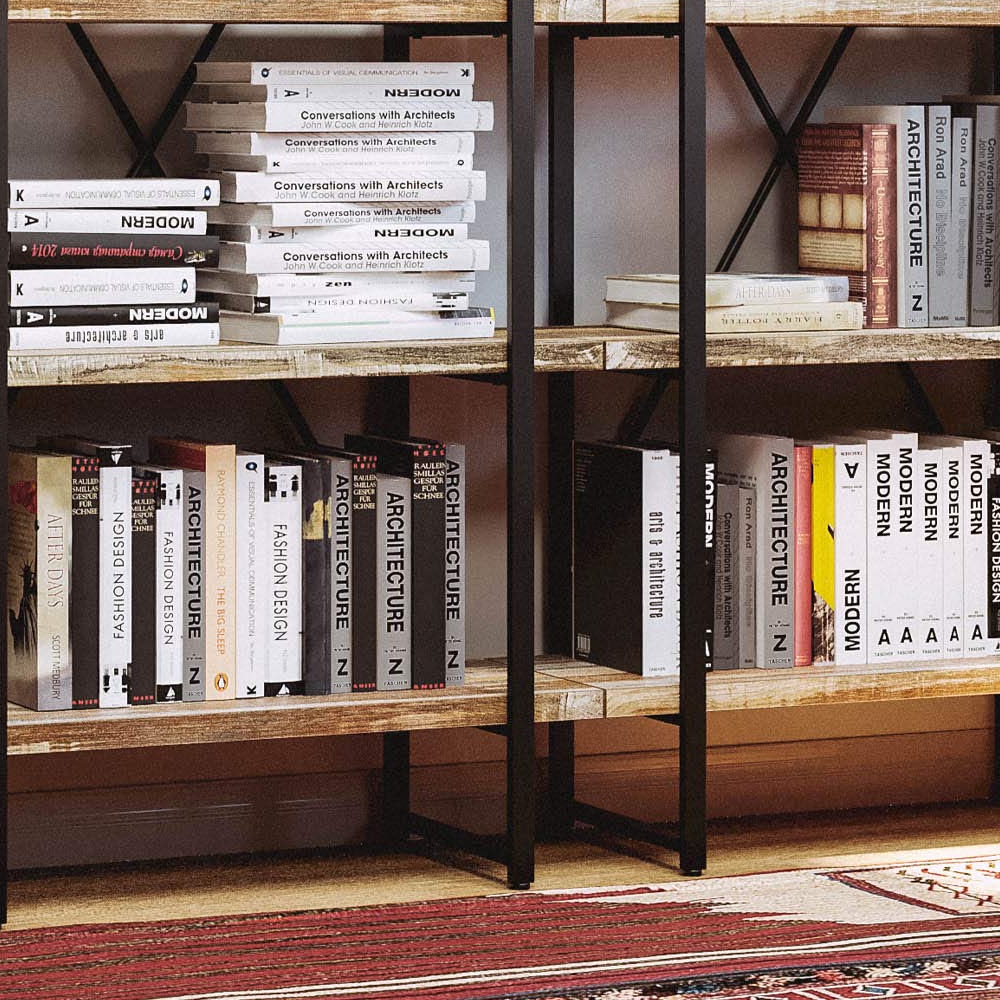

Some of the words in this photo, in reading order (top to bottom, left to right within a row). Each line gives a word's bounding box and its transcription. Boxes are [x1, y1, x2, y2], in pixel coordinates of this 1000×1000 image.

[301, 111, 376, 120] Conversations
[379, 111, 401, 119] with
[404, 111, 455, 119] Architects
[385, 89, 460, 97] MODERN
[301, 121, 321, 129] John
[274, 182, 355, 190] Conversations
[388, 181, 443, 189] Architects
[907, 119, 922, 267] ARCHITECTURE
[122, 216, 194, 228] MODERN
[374, 229, 454, 237] MODERN
[283, 252, 363, 261] Conversations
[367, 252, 389, 260] with
[393, 251, 448, 260] Architects
[129, 308, 208, 320] MODERN
[216, 471, 225, 520] RAYMOND
[877, 454, 890, 536] MODERN
[900, 448, 912, 532] MODERN
[925, 464, 937, 541] MODERN
[949, 461, 959, 538] MODERN
[971, 455, 982, 535] MODERN
[48, 514, 63, 562] AFTER
[113, 512, 125, 567] DESIGN
[447, 460, 460, 620] ARCHITECTURE
[649, 512, 664, 532] arts
[771, 453, 788, 606] ARCHITECTURE
[992, 498, 1000, 551] FASHION
[164, 531, 173, 590] FASHION
[188, 487, 200, 638] ARCHITECTURE
[216, 523, 225, 578] CHANDLER
[273, 525, 287, 584] FASHION
[336, 475, 349, 630] ARCHITECTURE
[387, 492, 404, 632] ARCHITECTURE
[48, 570, 63, 607] DAYS
[216, 589, 225, 604] THE
[650, 552, 664, 618] architecture
[992, 557, 1000, 602] DESIGN
[113, 574, 125, 639] FASHION
[164, 595, 173, 645] DESIGN
[216, 607, 225, 626] BIG
[273, 591, 287, 641] DESIGN
[845, 570, 860, 651] MODERN
[216, 628, 225, 655] SLEEP
